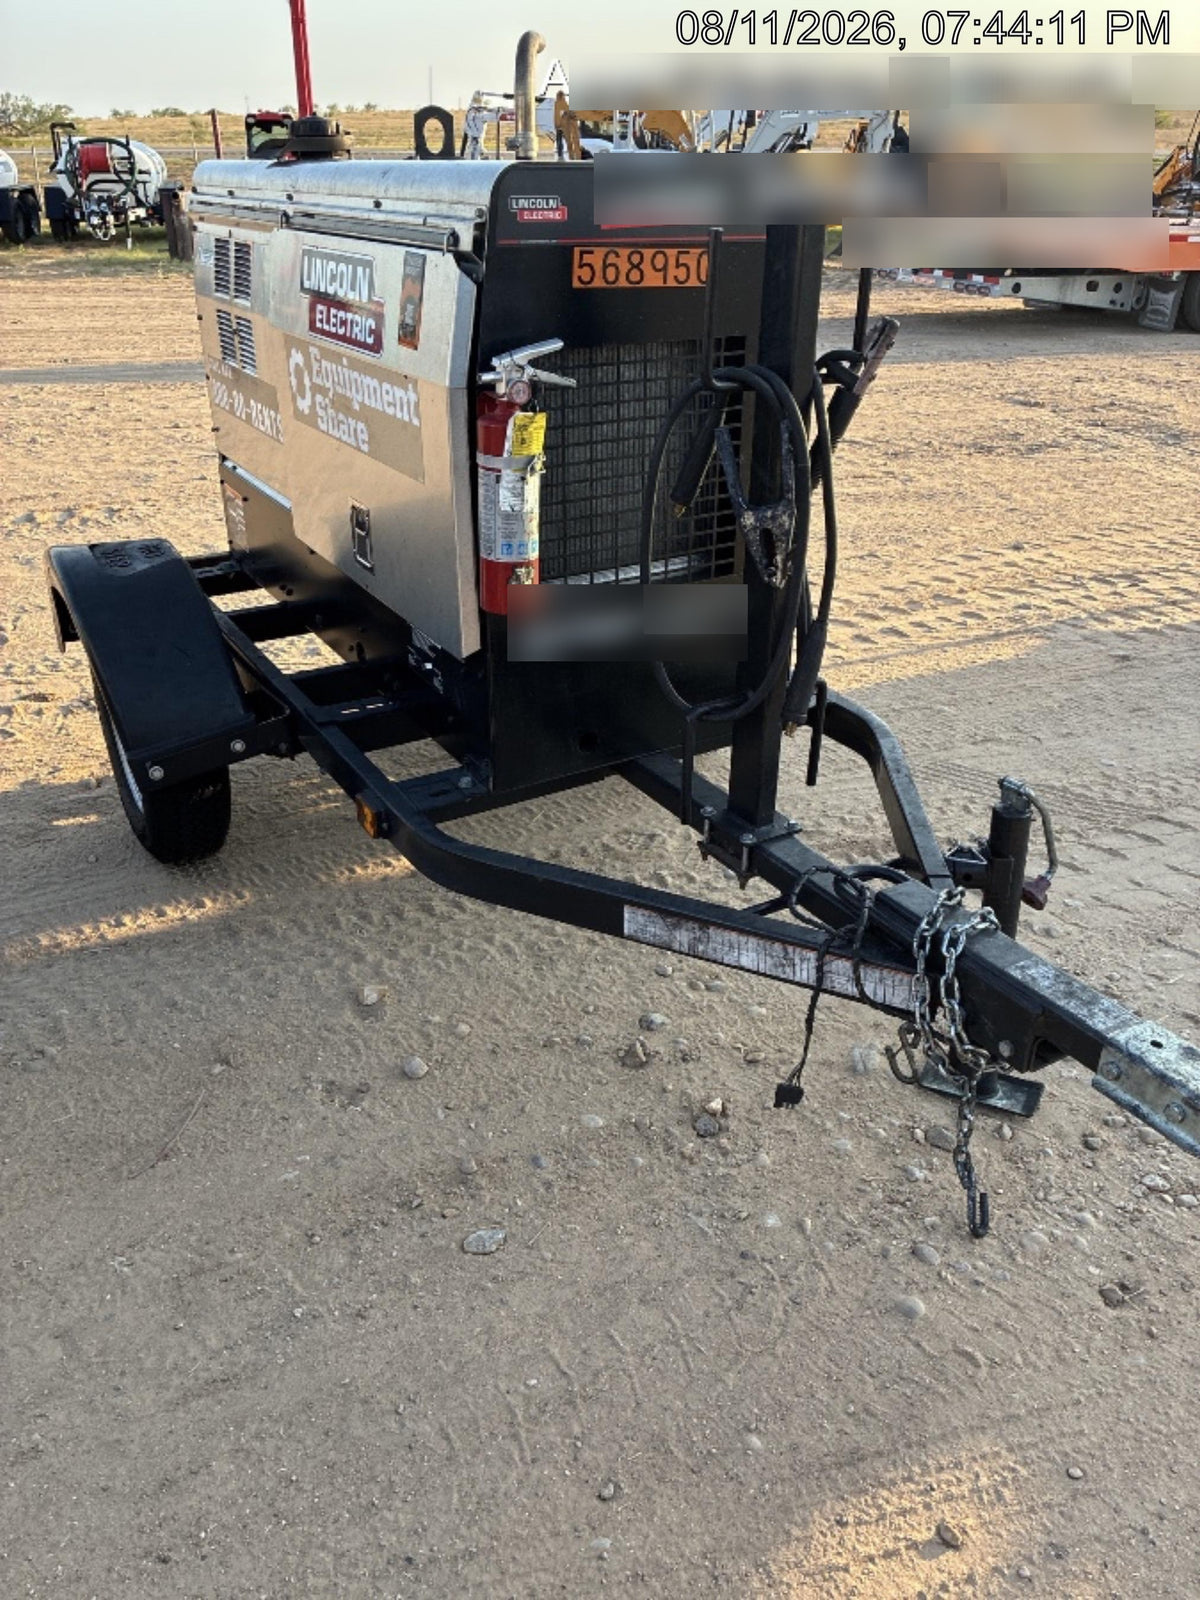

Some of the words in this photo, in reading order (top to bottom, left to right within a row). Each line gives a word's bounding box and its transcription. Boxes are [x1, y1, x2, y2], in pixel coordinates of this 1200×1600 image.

[511, 198, 558, 209] LINCOLN
[303, 255, 370, 302] LINCOLN
[576, 250, 709, 286] 568950
[315, 303, 376, 344] ELECTRIC
[309, 345, 420, 428] Equipment
[315, 393, 370, 452] Share
